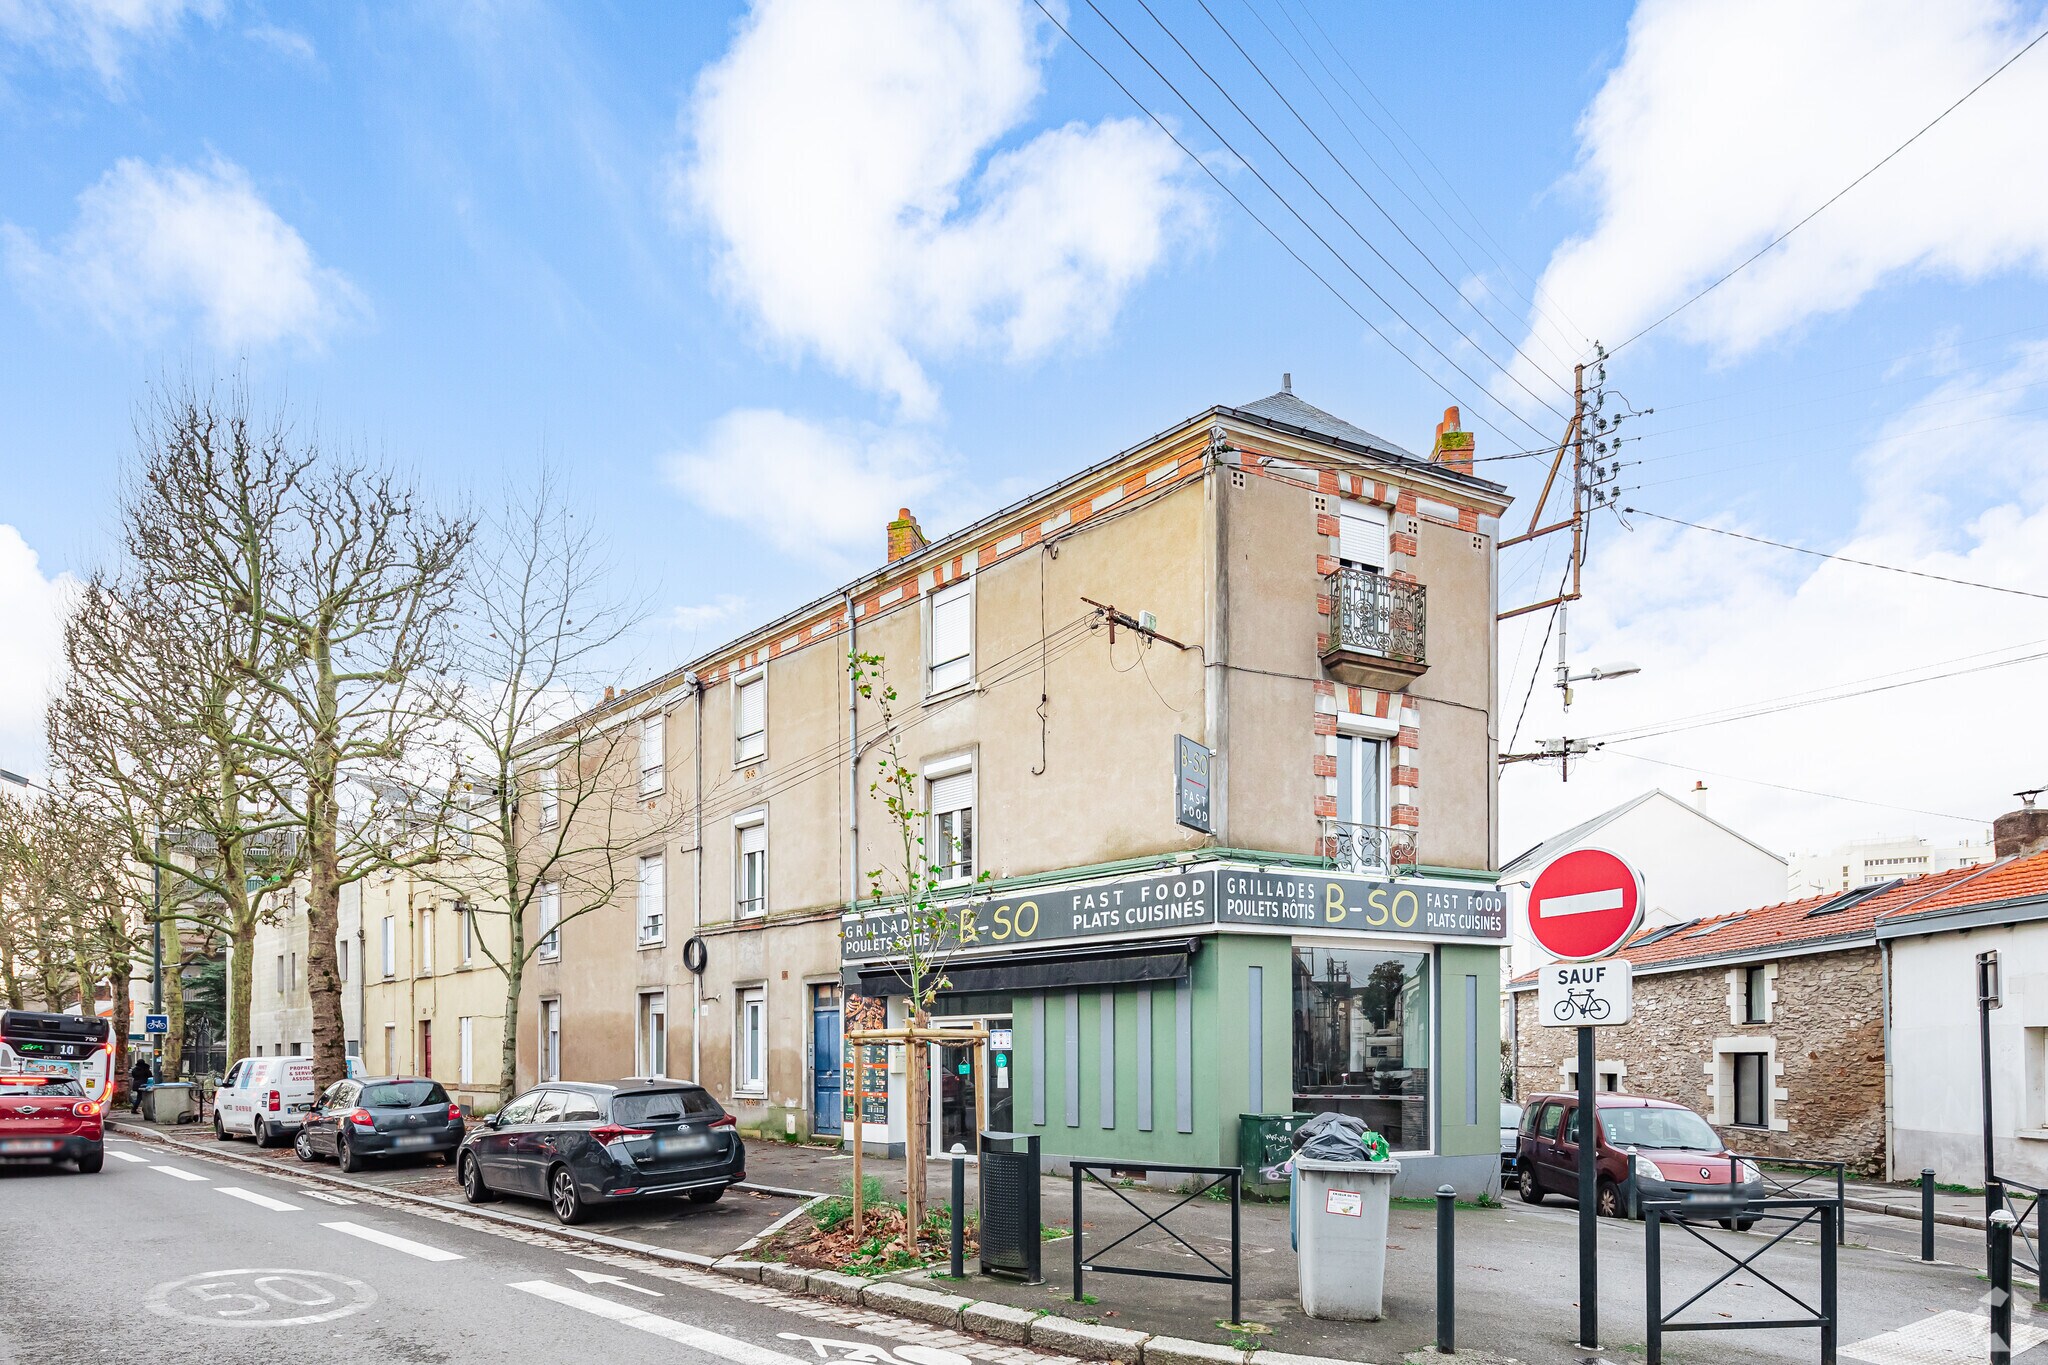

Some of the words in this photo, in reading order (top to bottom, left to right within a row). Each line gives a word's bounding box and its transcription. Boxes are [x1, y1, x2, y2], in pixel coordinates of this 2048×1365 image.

[1182, 744, 1208, 776] B-SO
[1184, 789, 1206, 807] FAST
[1183, 803, 1208, 822] FOOD
[1073, 890, 1124, 911] FAST
[1141, 879, 1206, 903] FOOD
[1227, 877, 1315, 899] GRILLADES
[1227, 899, 1279, 918] POULETS
[1282, 899, 1315, 920] RÔTIS
[1326, 883, 1419, 928] B-SO
[1427, 892, 1458, 909] FAST
[1467, 896, 1502, 912] FOOD
[960, 901, 1039, 943] B-SO
[1073, 910, 1120, 930] PLATS
[1125, 897, 1205, 924] CUISINÉS
[1427, 912, 1456, 929] PLATS
[1458, 912, 1501, 931] CUISINÉS
[846, 936, 892, 954] POULETS
[1558, 967, 1606, 985] SAUF
[60, 1044, 74, 1055] 10
[186, 1275, 336, 1317] 50
